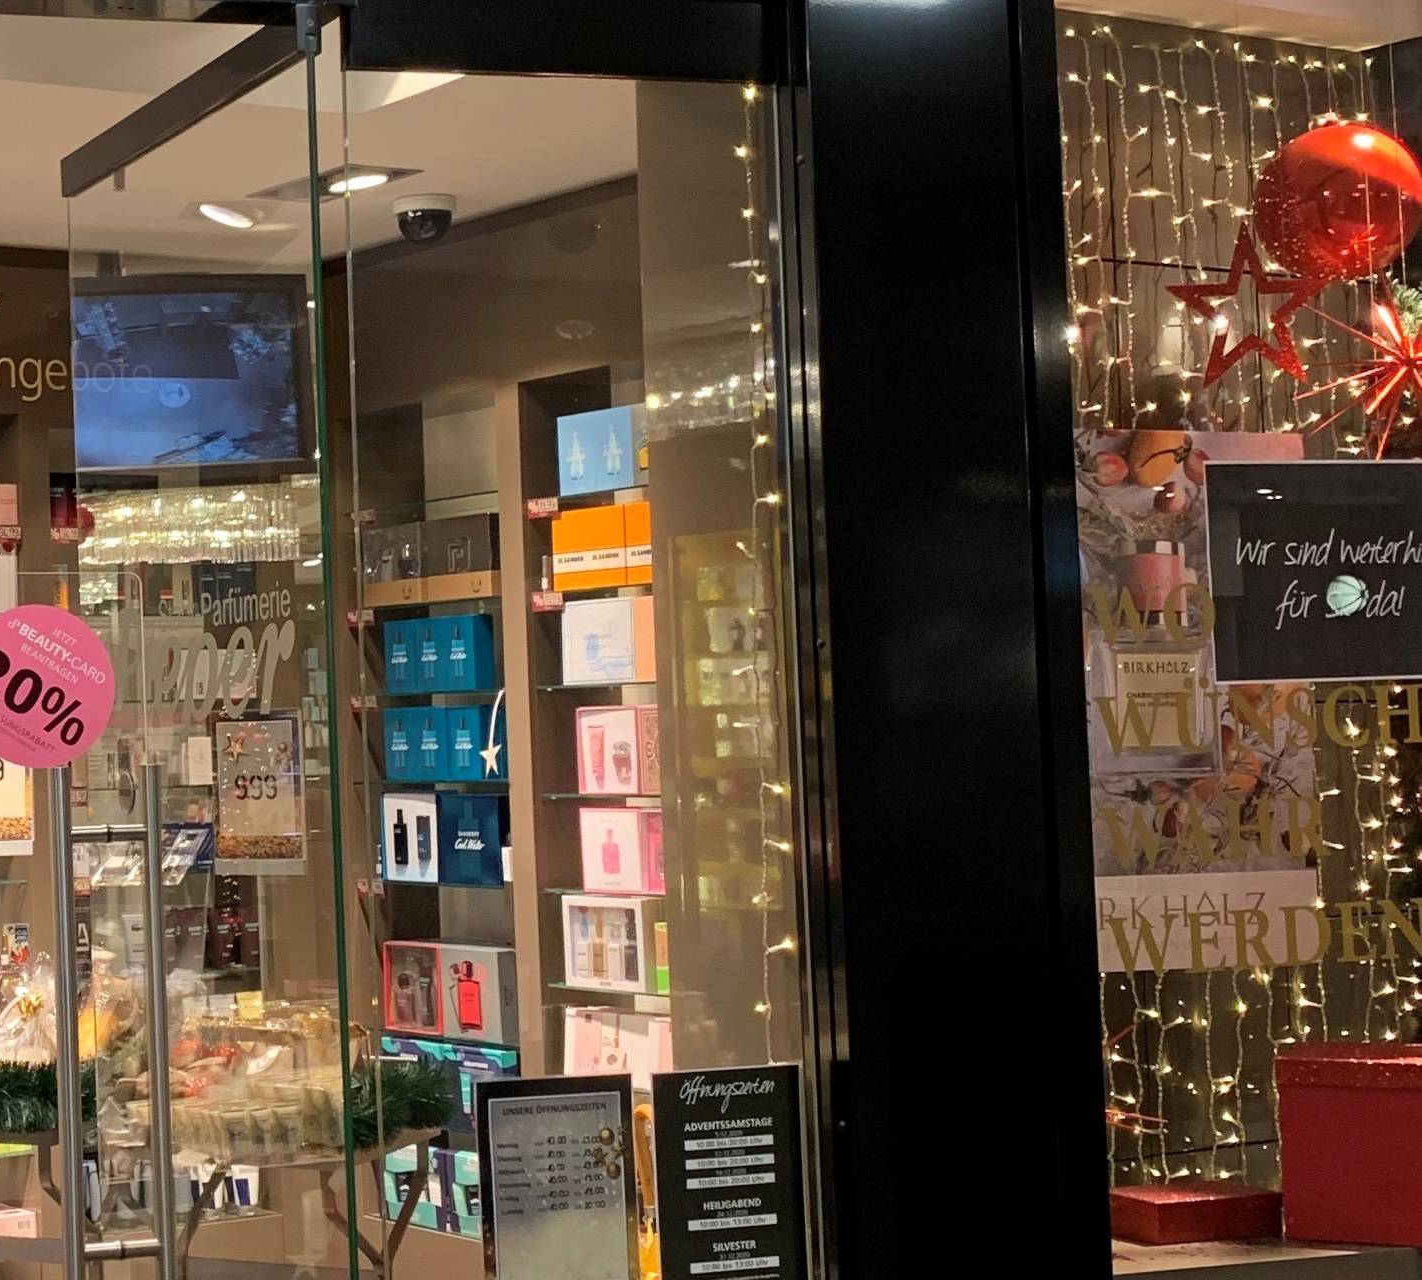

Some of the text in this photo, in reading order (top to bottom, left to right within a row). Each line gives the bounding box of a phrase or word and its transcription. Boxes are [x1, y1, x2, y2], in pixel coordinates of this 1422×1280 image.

[1235, 537, 1276, 566] Wir
[1284, 528, 1335, 567] sind
[201, 580, 291, 626] Parfümerie
[1085, 583, 1216, 648] WO
[1275, 579, 1405, 630] für da!
[51, 628, 78, 647] JETZT
[20, 643, 79, 686] BEANTRAGEN
[234, 774, 278, 800] 9.99
[1099, 798, 1329, 869] WAHR
[1102, 897, 1422, 976] WERDEN
[502, 1102, 607, 1116] UNSERE ÖFFNUNGSZEITEN
[684, 1117, 773, 1132] ADVENTSSAMSTAGE
[703, 1198, 762, 1211] HEILIGABEND
[713, 1240, 756, 1252] SILVESTER
